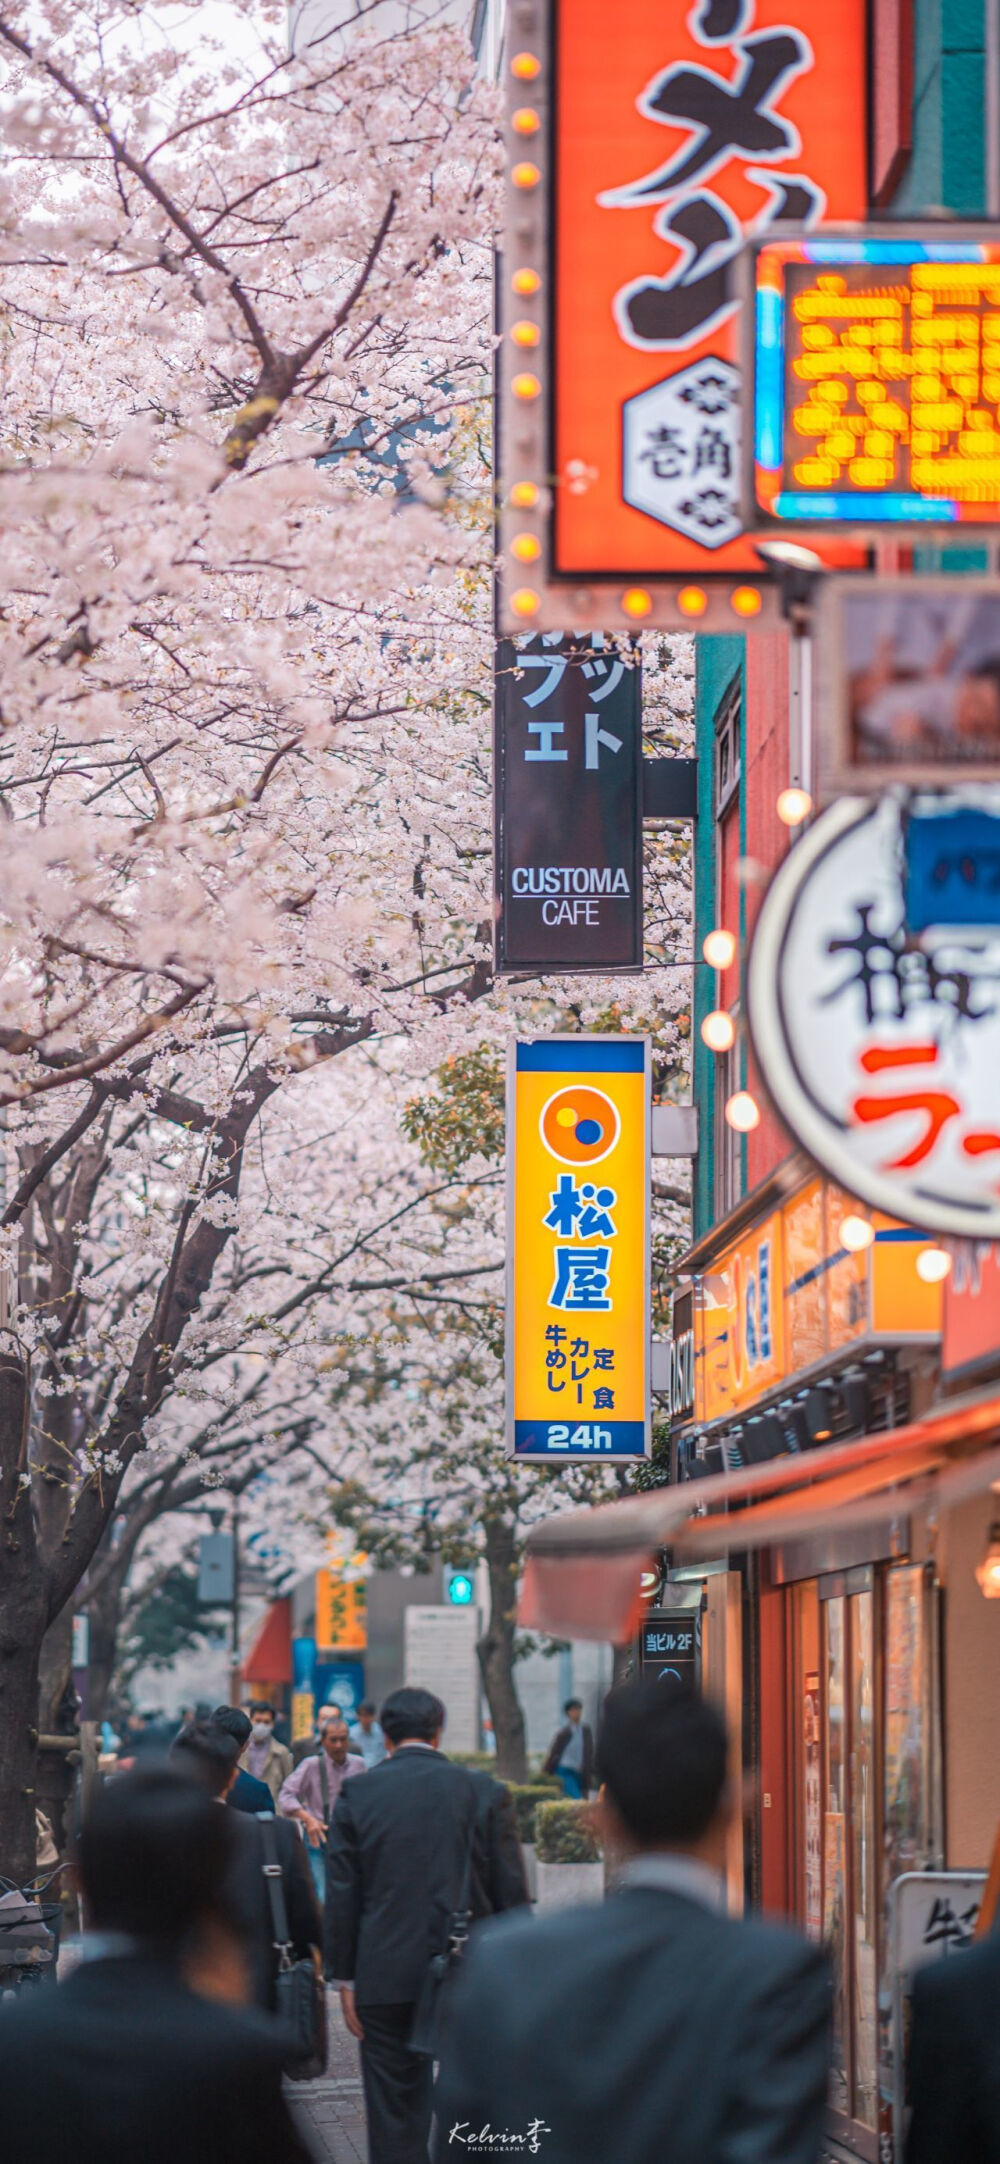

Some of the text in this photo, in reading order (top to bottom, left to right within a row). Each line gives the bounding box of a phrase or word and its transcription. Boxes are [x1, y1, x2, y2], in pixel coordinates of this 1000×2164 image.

[598, 0, 826, 350] メン
[512, 867, 630, 893] CUSTOMA
[542, 899, 600, 925] CAFE
[543, 1174, 618, 1311] 松屋
[545, 1324, 567, 1393] 牛めし
[570, 1337, 589, 1404] カレー
[593, 1347, 615, 1410] 定食
[547, 1424, 612, 1450] 24h
